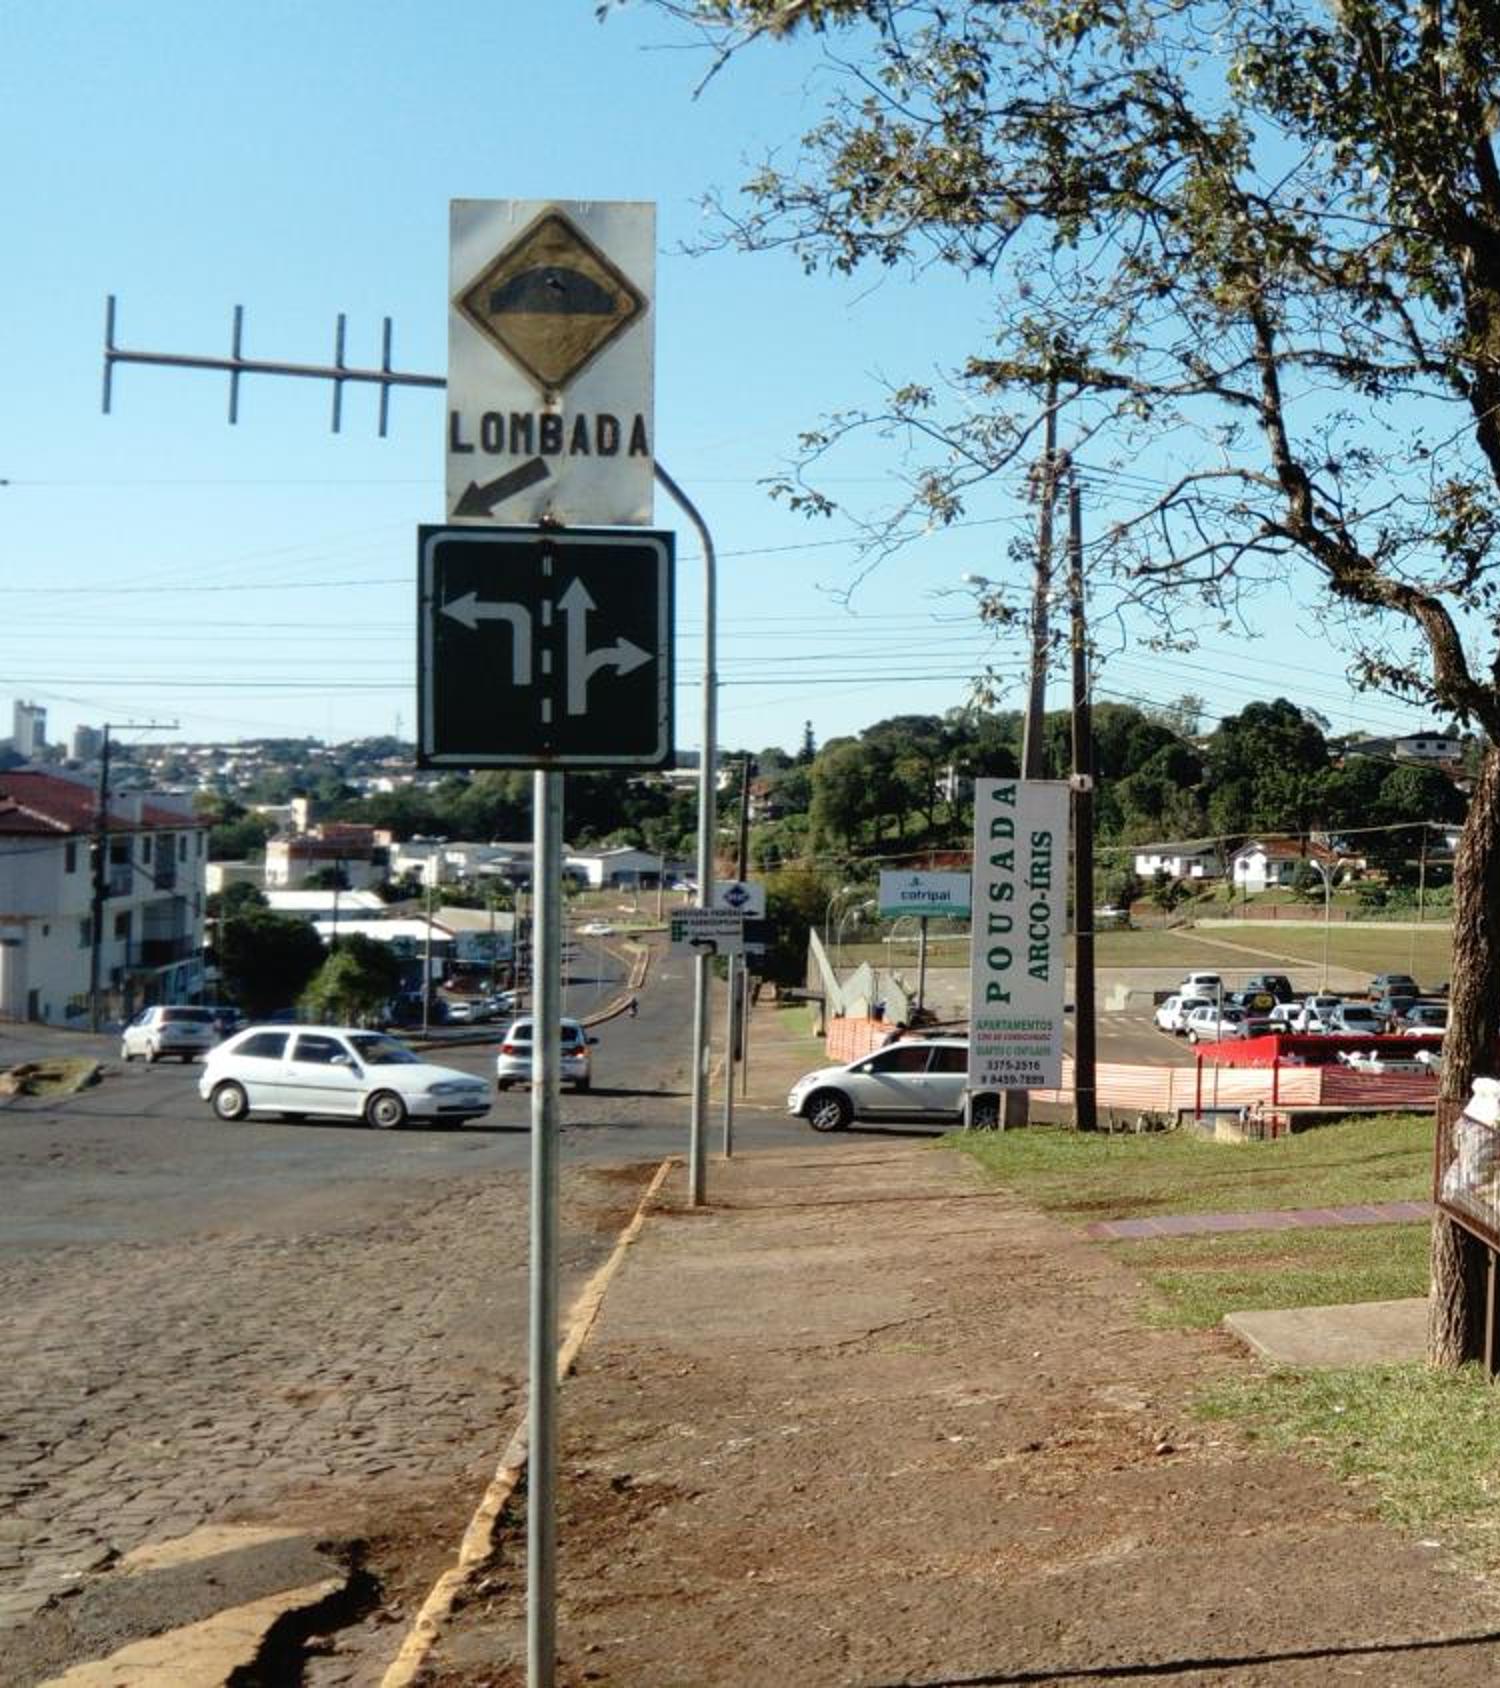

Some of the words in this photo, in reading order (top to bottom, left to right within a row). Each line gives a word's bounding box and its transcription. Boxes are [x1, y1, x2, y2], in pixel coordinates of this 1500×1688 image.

[450, 411, 650, 457] LOMBADA
[986, 784, 1016, 1004] POUSADA
[1025, 831, 1052, 982] ARCO-ÍRIS
